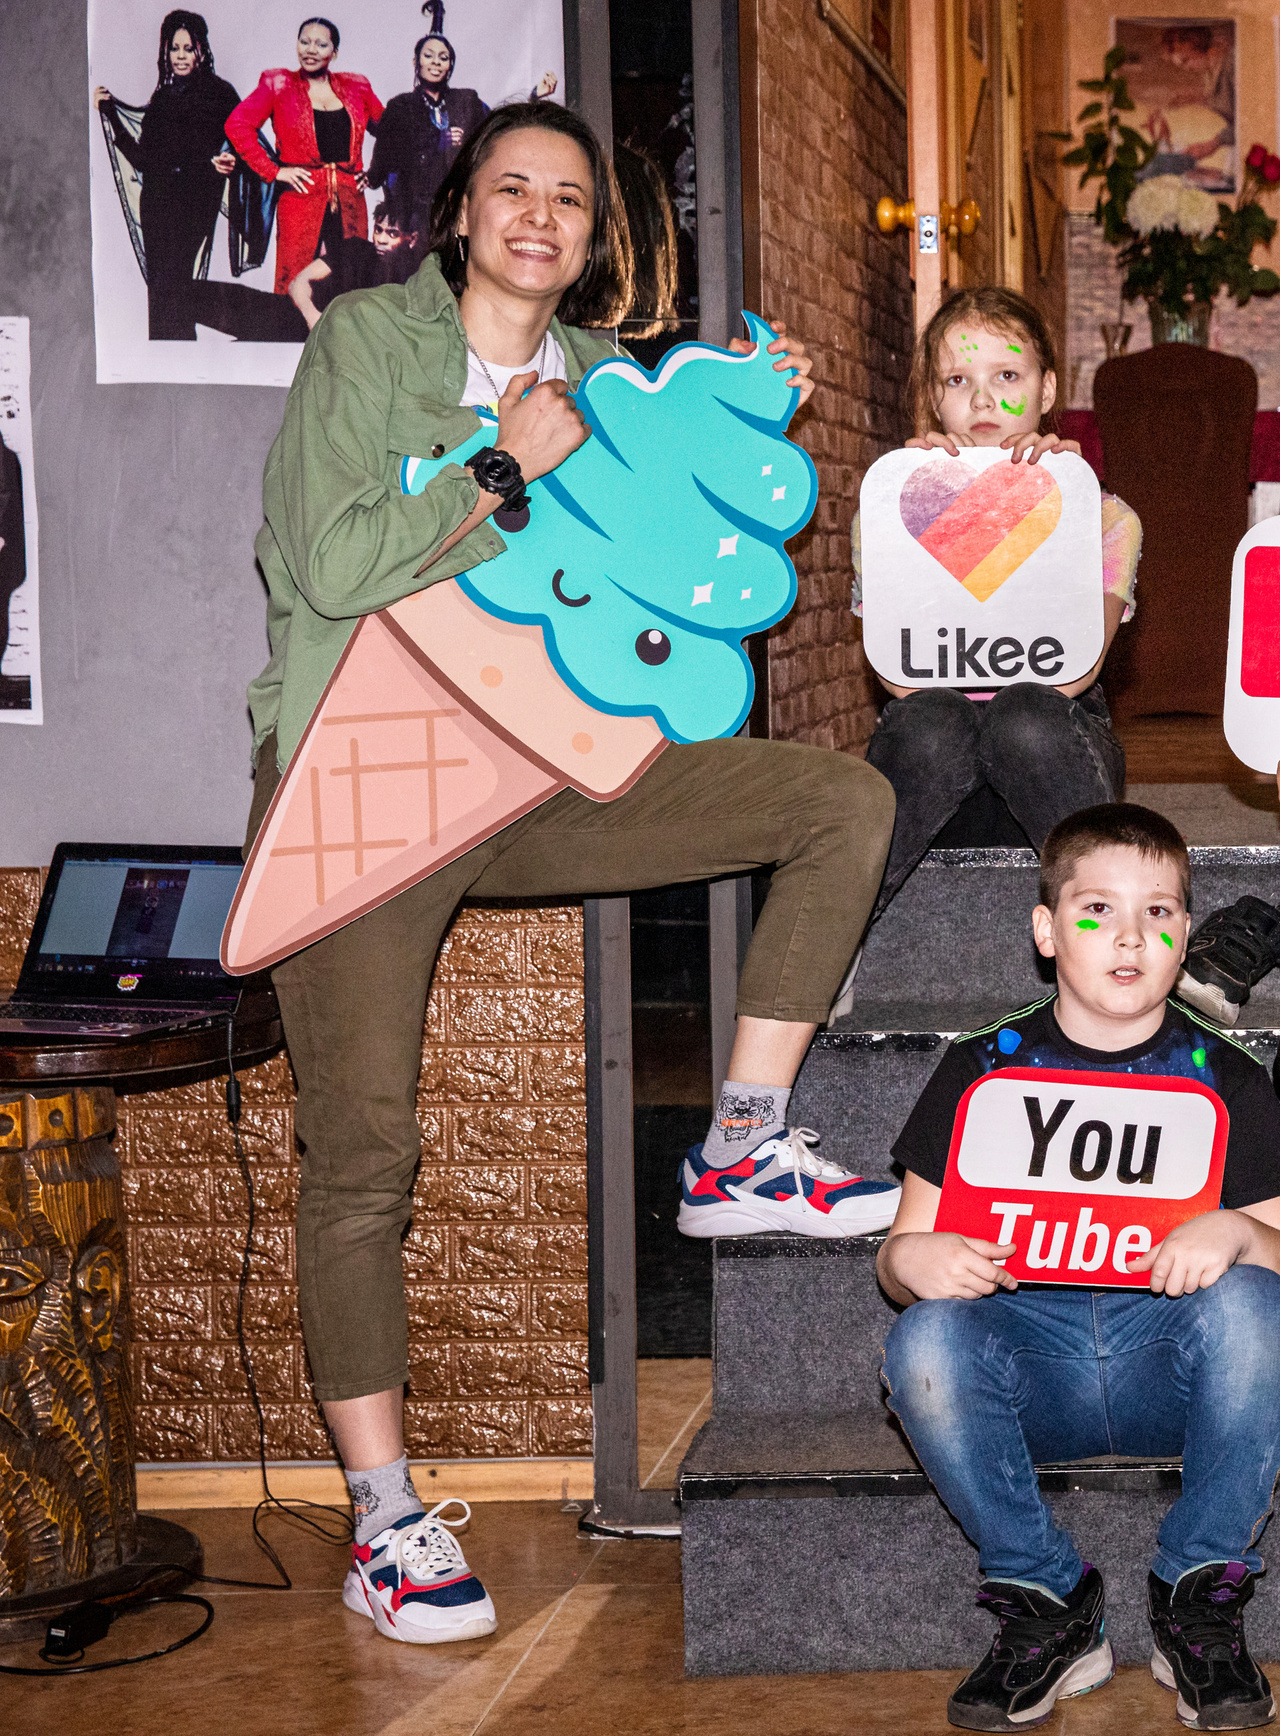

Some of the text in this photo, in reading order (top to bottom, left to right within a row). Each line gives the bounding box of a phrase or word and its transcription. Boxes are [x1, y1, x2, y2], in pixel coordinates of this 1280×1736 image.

[900, 627, 1065, 678] Likee
[1023, 1096, 1162, 1185] You
[990, 1201, 1153, 1274] Tube
